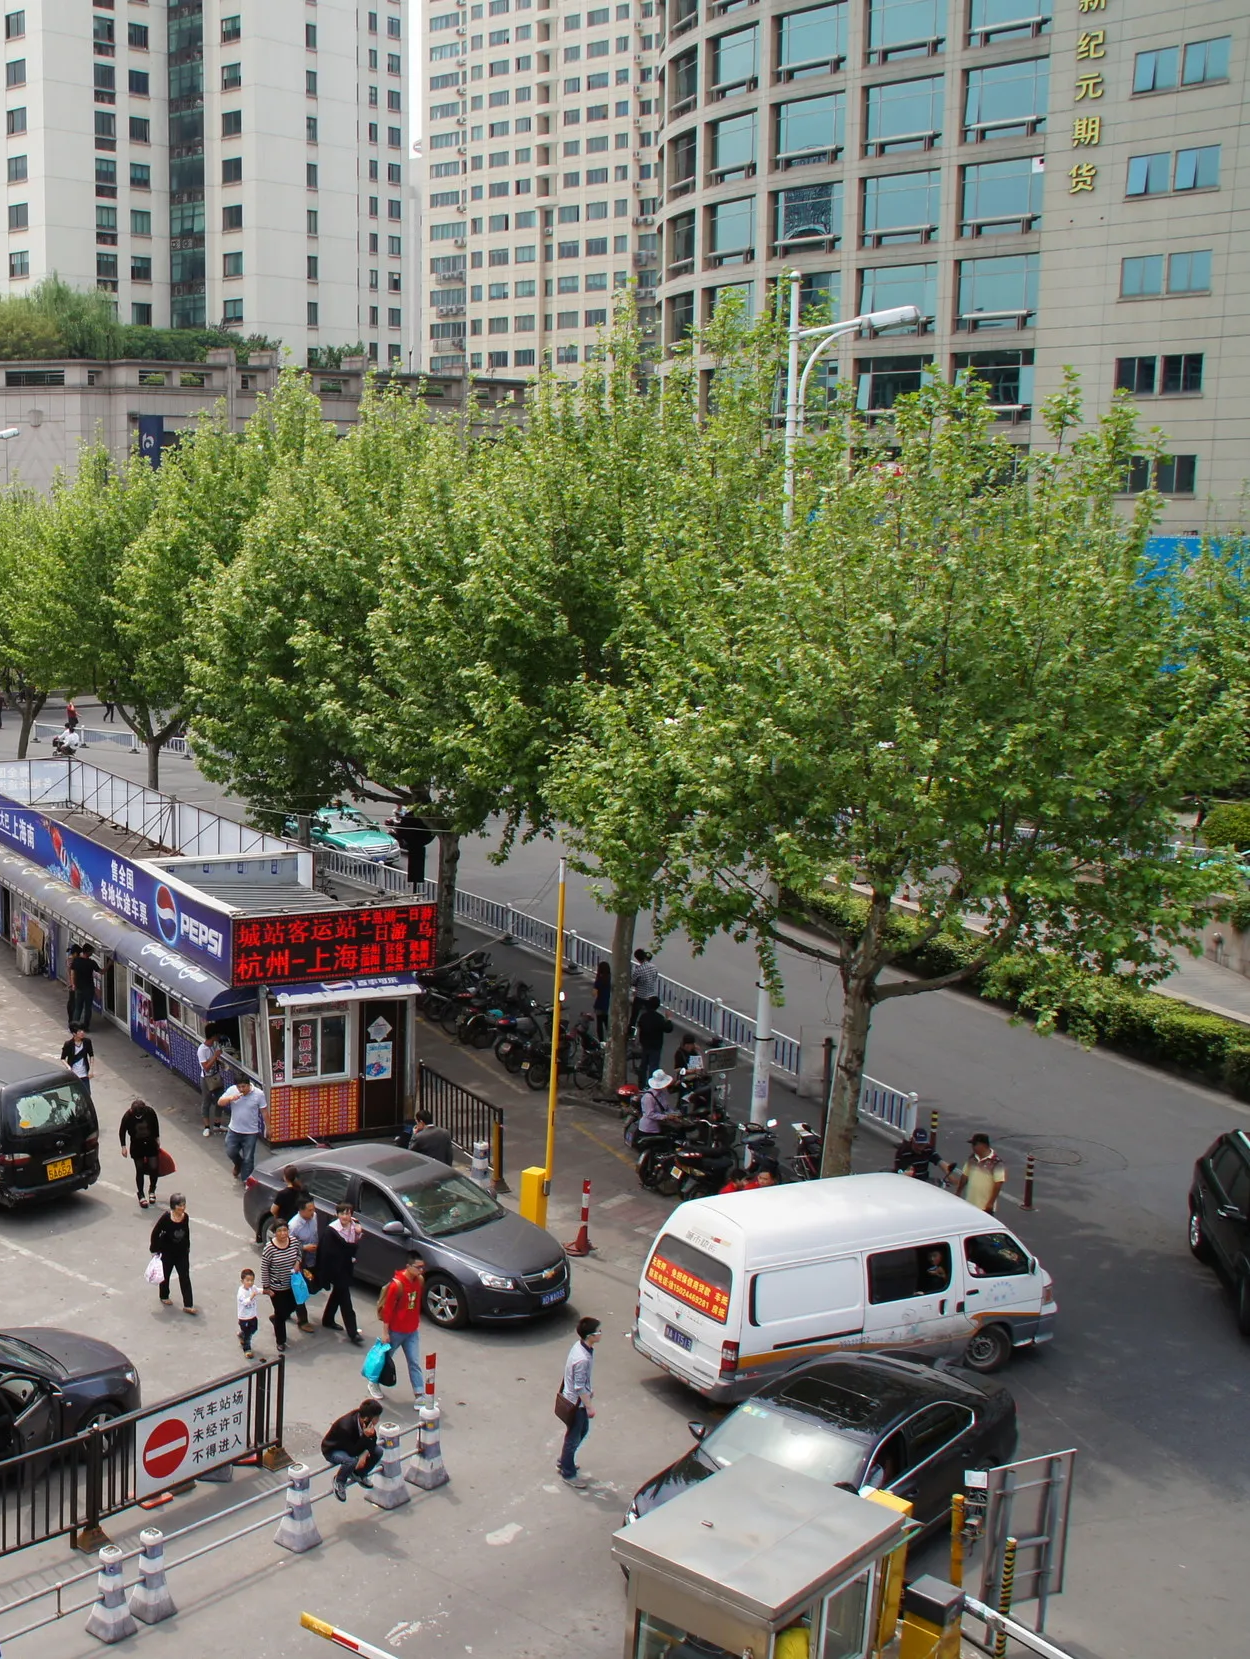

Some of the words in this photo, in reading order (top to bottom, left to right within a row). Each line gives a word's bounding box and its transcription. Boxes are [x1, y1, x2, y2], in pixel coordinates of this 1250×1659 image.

[12, 815, 34, 849] 上海南
[111, 859, 134, 892] 售全国
[101, 879, 148, 925] 各地长途车票
[180, 912, 223, 958] PEPSI
[237, 916, 358, 949] 城站客运站
[193, 1390, 244, 1422] 汽车站场
[192, 1411, 243, 1443] 未经许可
[192, 1433, 242, 1464] 不得进入
